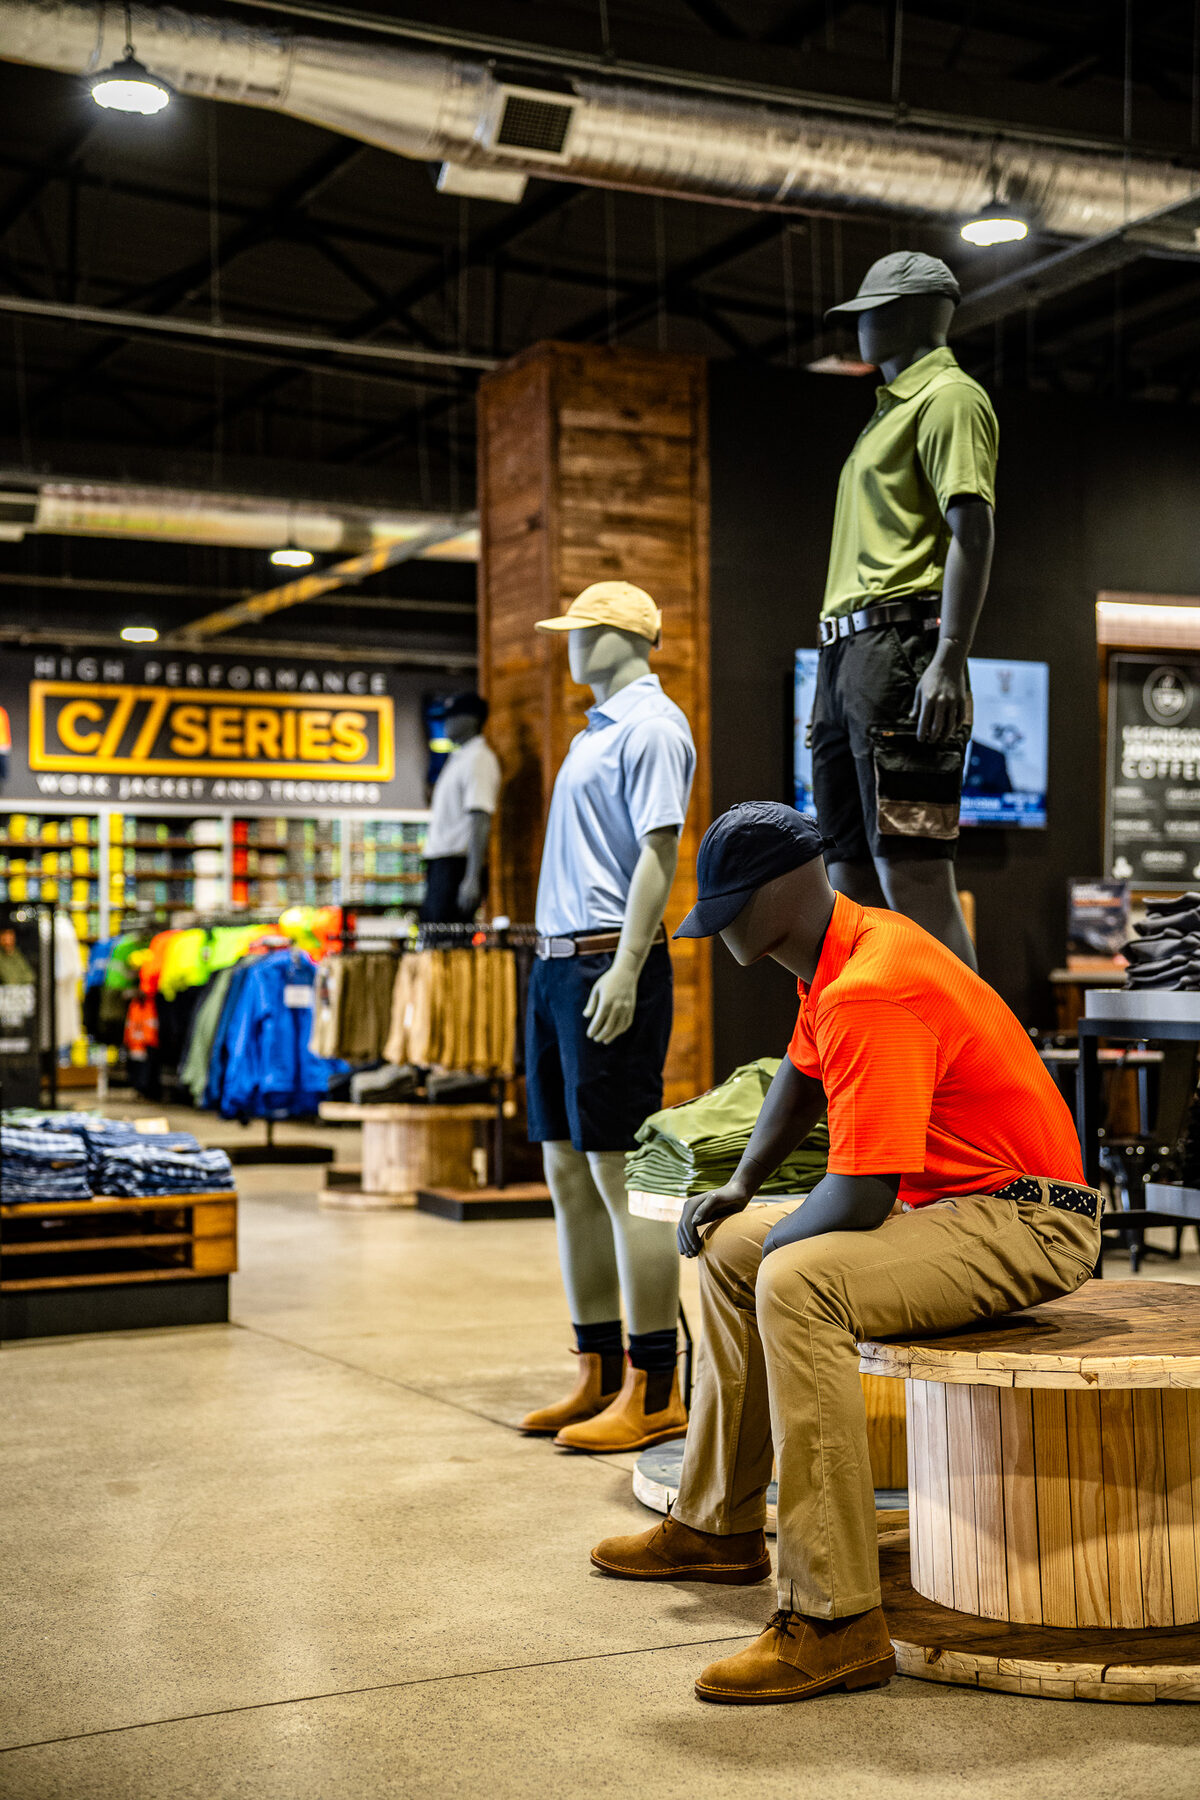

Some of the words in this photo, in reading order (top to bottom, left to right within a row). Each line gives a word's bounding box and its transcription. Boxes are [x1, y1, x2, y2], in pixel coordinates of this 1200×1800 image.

[34, 655, 124, 683] HIGH
[144, 661, 387, 696] PERFORMANCE
[36, 773, 112, 797] WORK
[118, 776, 204, 800] JACKET
[211, 779, 264, 801] AND
[268, 780, 381, 804] TROUSERS
